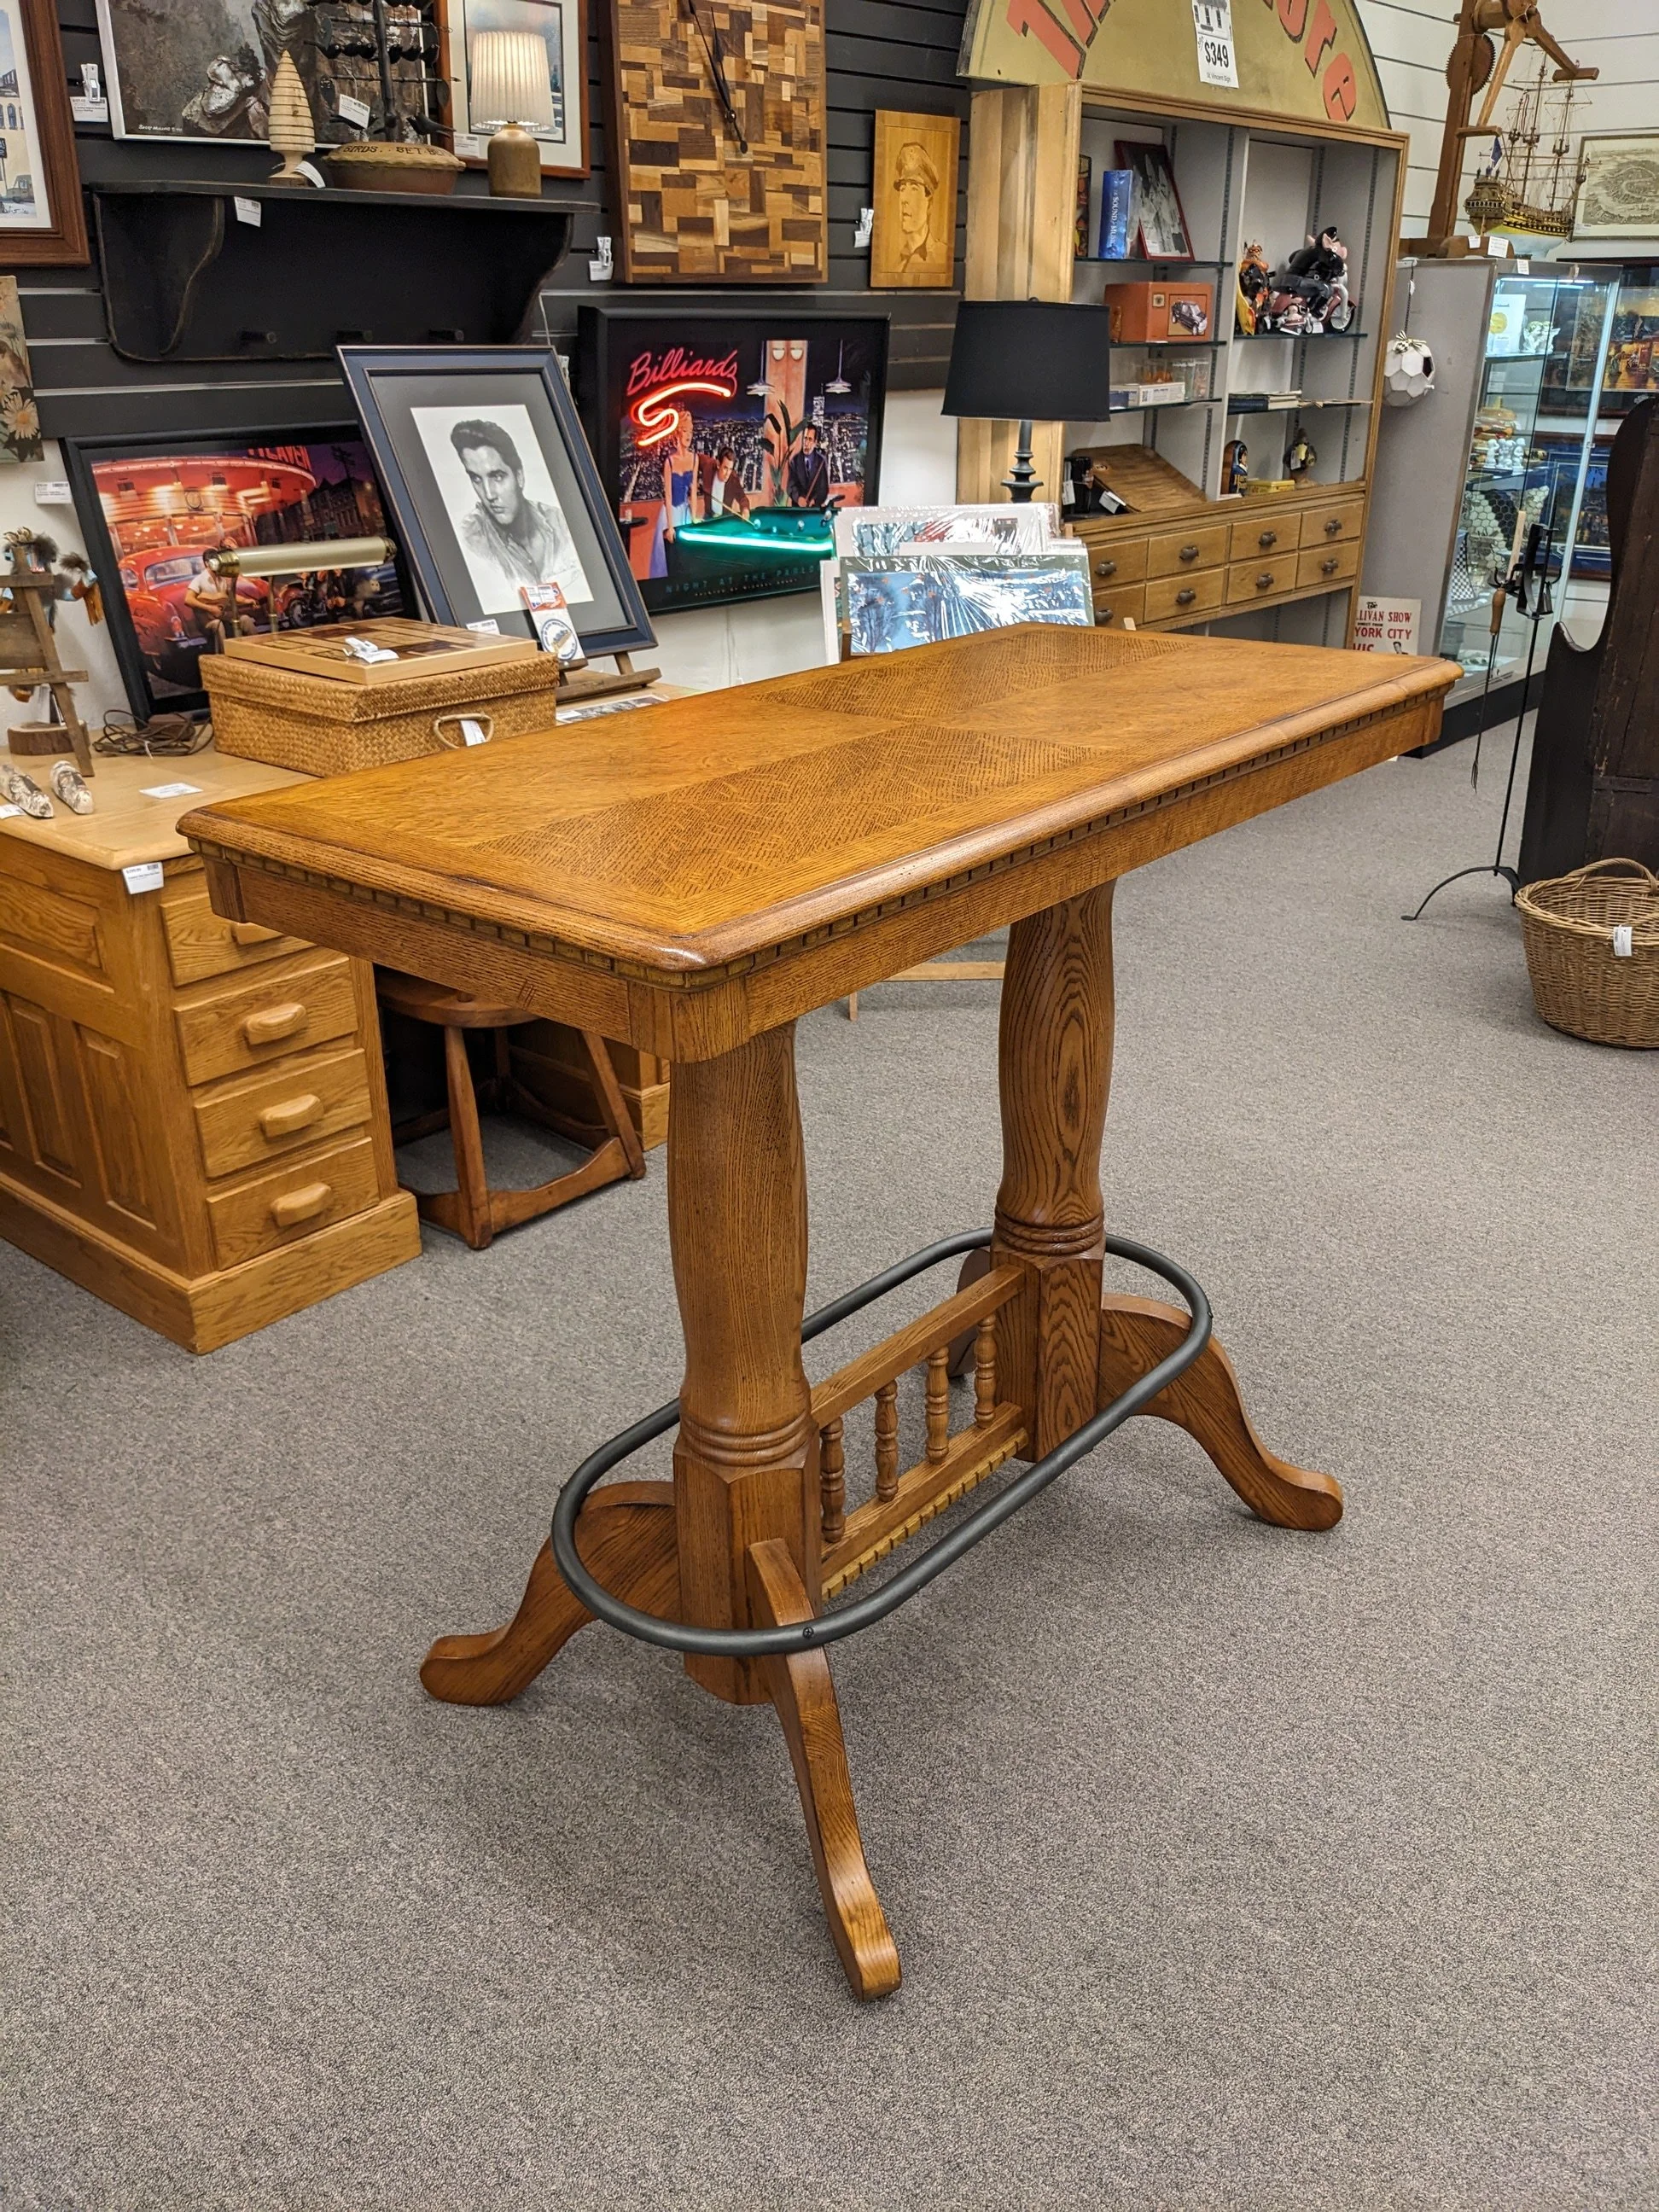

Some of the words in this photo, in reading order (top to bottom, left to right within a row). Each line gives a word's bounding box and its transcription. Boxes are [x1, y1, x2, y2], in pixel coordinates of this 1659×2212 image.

[1204, 40, 1229, 68] $349
[1111, 196, 1120, 221] SOUND
[626, 347, 738, 398] Billiards
[666, 580, 707, 594] NIGHT
[719, 574, 733, 585] AT
[744, 572, 765, 582] THE
[1355, 609, 1384, 622] LIVAN
[1388, 611, 1412, 623] SHOW
[1354, 626, 1382, 638] YORK
[1387, 628, 1412, 640] CITY
